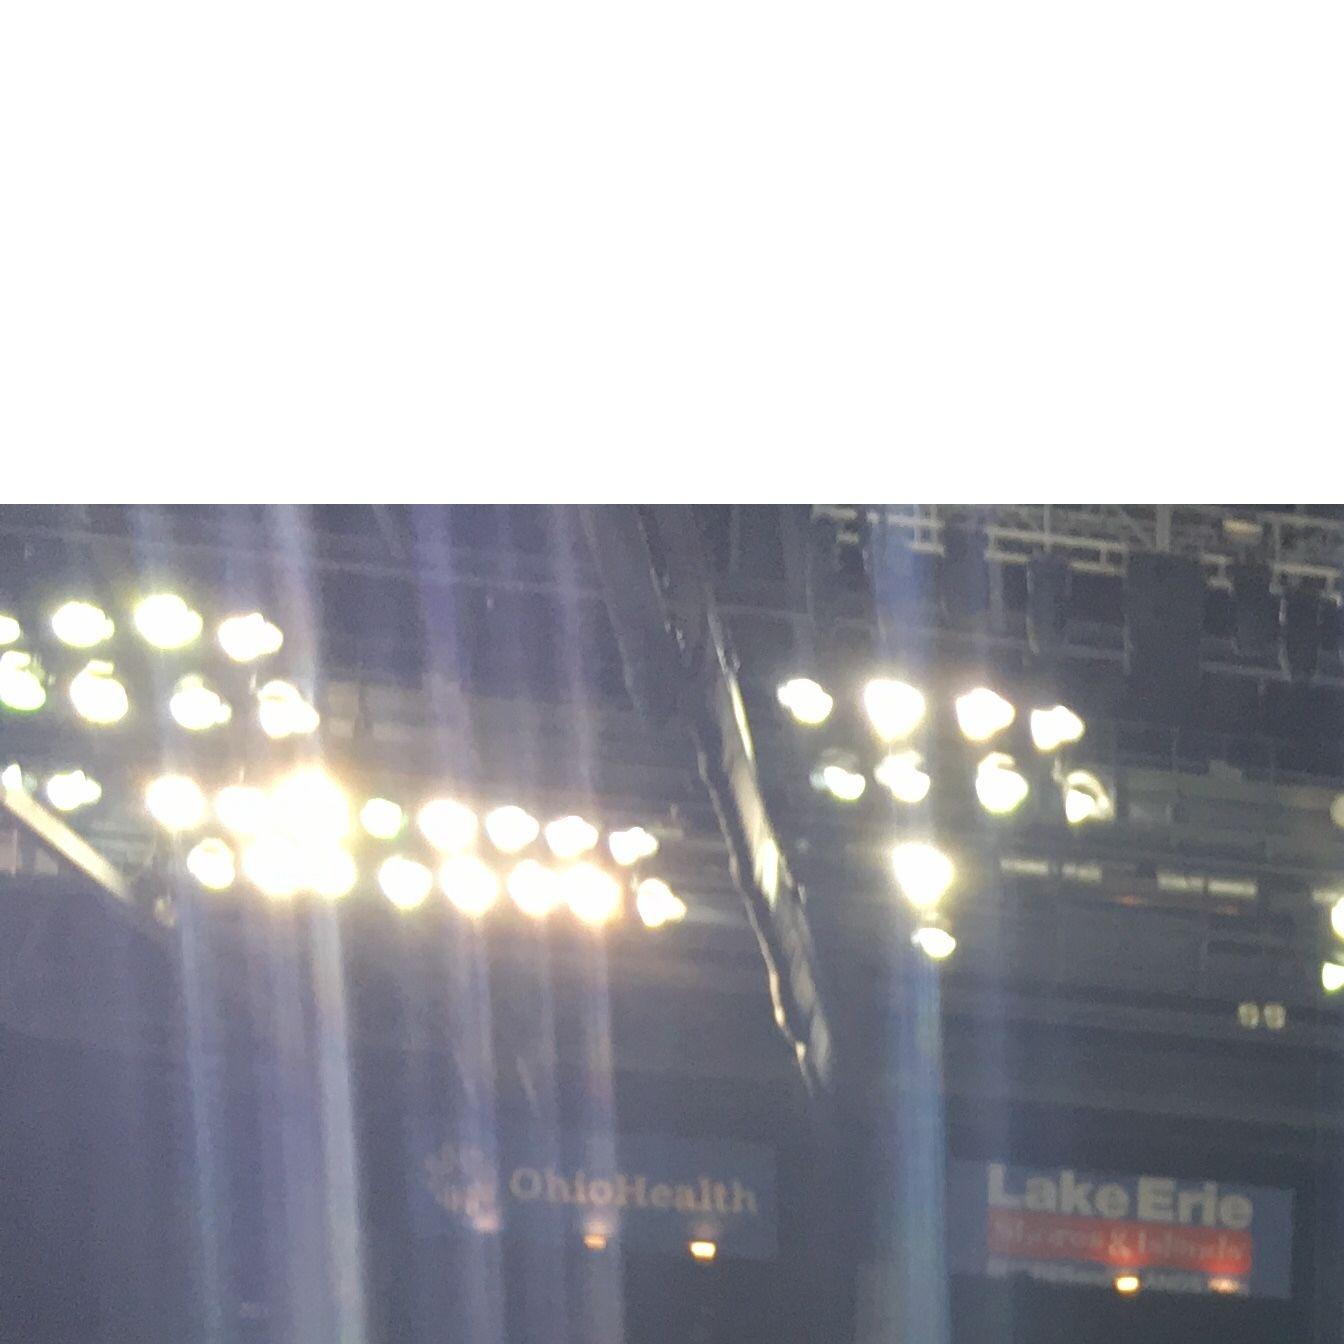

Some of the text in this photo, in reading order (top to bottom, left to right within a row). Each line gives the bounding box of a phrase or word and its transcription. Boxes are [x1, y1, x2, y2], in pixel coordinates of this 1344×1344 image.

[508, 1164, 758, 1213] OhioHealth
[987, 1163, 1253, 1229] Lake Erie
